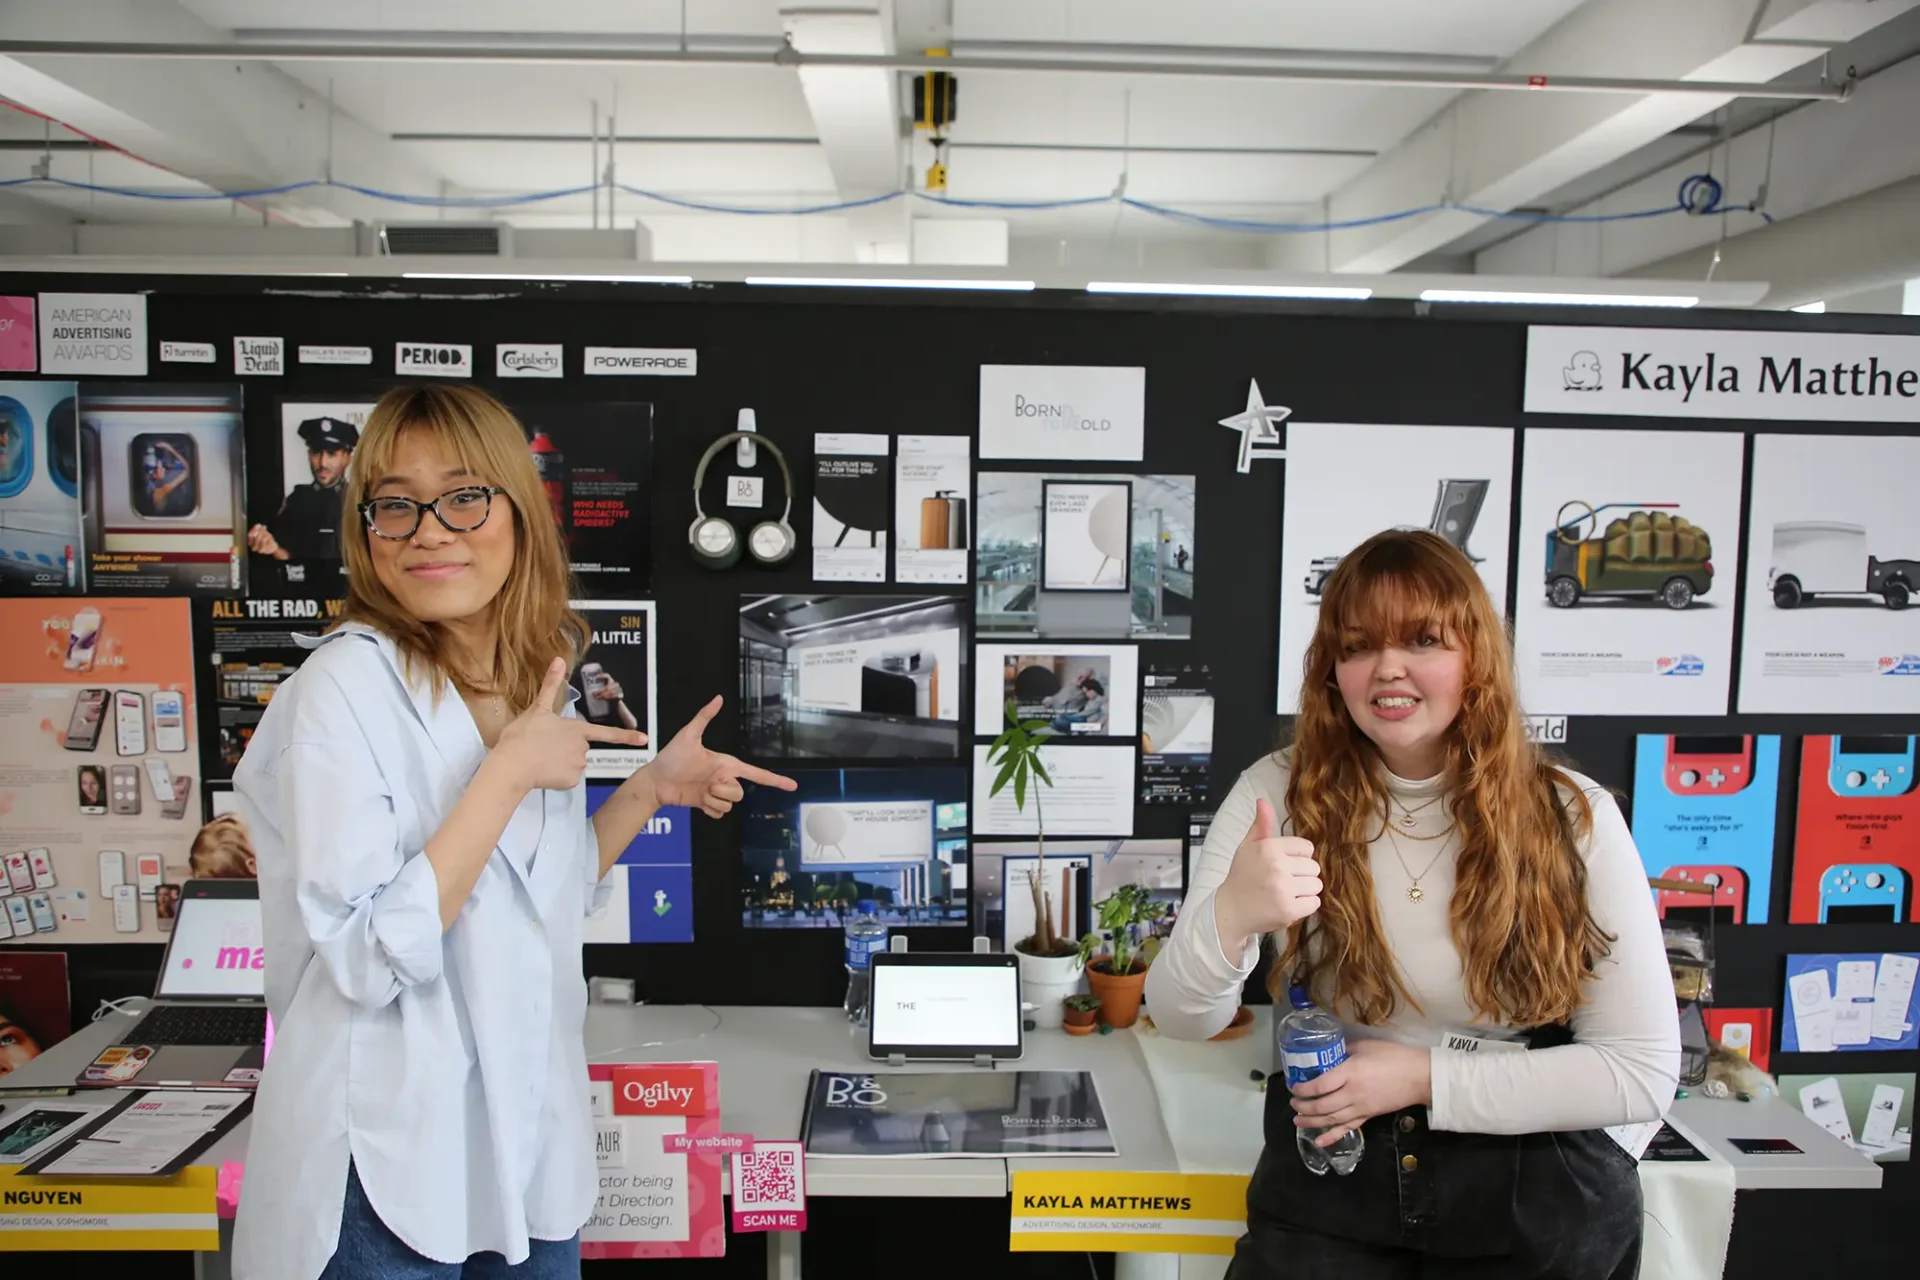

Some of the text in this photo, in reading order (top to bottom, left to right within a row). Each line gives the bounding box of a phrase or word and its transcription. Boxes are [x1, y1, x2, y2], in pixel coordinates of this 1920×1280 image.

[51, 308, 132, 322] AMERICAN
[53, 327, 132, 339] ADVERTISING
[54, 344, 133, 361] AWARDS
[239, 340, 280, 359] Liquid
[402, 348, 466, 366] PERIOD.
[502, 351, 559, 371] Carlsberg
[594, 357, 690, 368] POWERADE
[244, 357, 280, 372] Death
[1621, 352, 1919, 403] Kayla Matthe
[1015, 394, 1061, 417] BORN
[1081, 419, 1111, 431] OLD
[573, 500, 625, 508] WHO NEEDS
[573, 509, 631, 518] RADIOACTIVE
[113, 554, 132, 562] your
[93, 563, 140, 571] ANYWHERE.
[212, 601, 243, 618] ALL
[246, 600, 280, 618] THE
[283, 600, 322, 619] RAD,
[621, 616, 641, 629] SIN
[591, 631, 641, 645] A LITTLE
[1693, 815, 1711, 823] only
[1691, 825, 1718, 833] asking
[896, 1001, 917, 1010] THE
[1448, 1036, 1479, 1052] KAYLA
[623, 1080, 694, 1108] Ogilvy
[596, 1131, 620, 1153] AUR
[675, 1136, 743, 1149] My website
[599, 1175, 674, 1190] ctor being
[4, 1191, 82, 1205] NGUYEN
[608, 1194, 674, 1207] Direction
[1023, 1195, 1191, 1210] KAYLA MATTHEWS
[56, 1218, 109, 1226] SOPHOMORE
[619, 1213, 673, 1229] Design.
[743, 1215, 798, 1226] SCAN ME
[1022, 1221, 1076, 1229] ADVERTISING
[1111, 1221, 1164, 1230] SOPHOMORE
